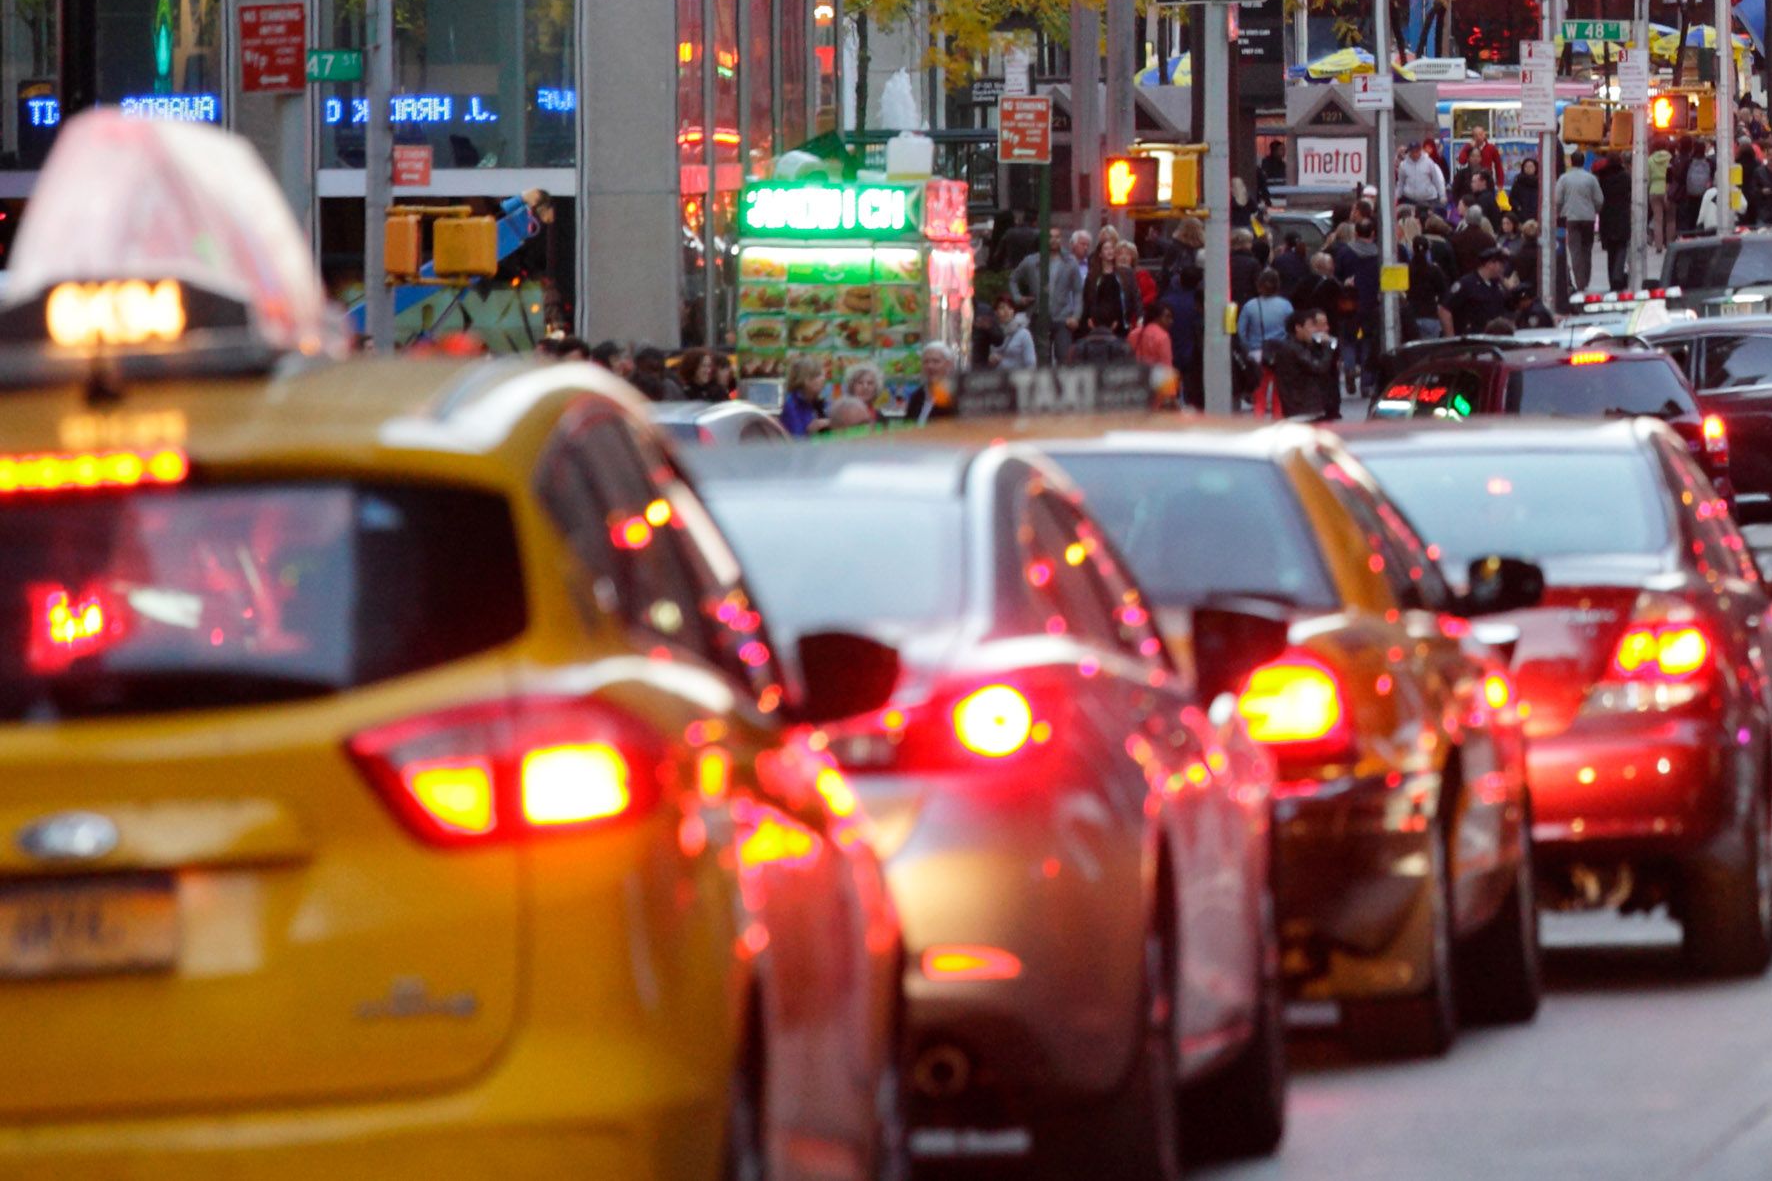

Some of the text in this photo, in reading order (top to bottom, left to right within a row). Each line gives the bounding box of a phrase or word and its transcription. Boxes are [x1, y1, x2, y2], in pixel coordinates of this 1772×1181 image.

[1565, 23, 1578, 39] W
[1584, 23, 1605, 39] 48
[306, 53, 335, 78] 47
[342, 52, 358, 66] ST
[1002, 101, 1047, 112] NO STANDING
[1321, 110, 1343, 122] 1221
[1303, 147, 1362, 175] metro
[1008, 368, 1098, 411] TAXI
